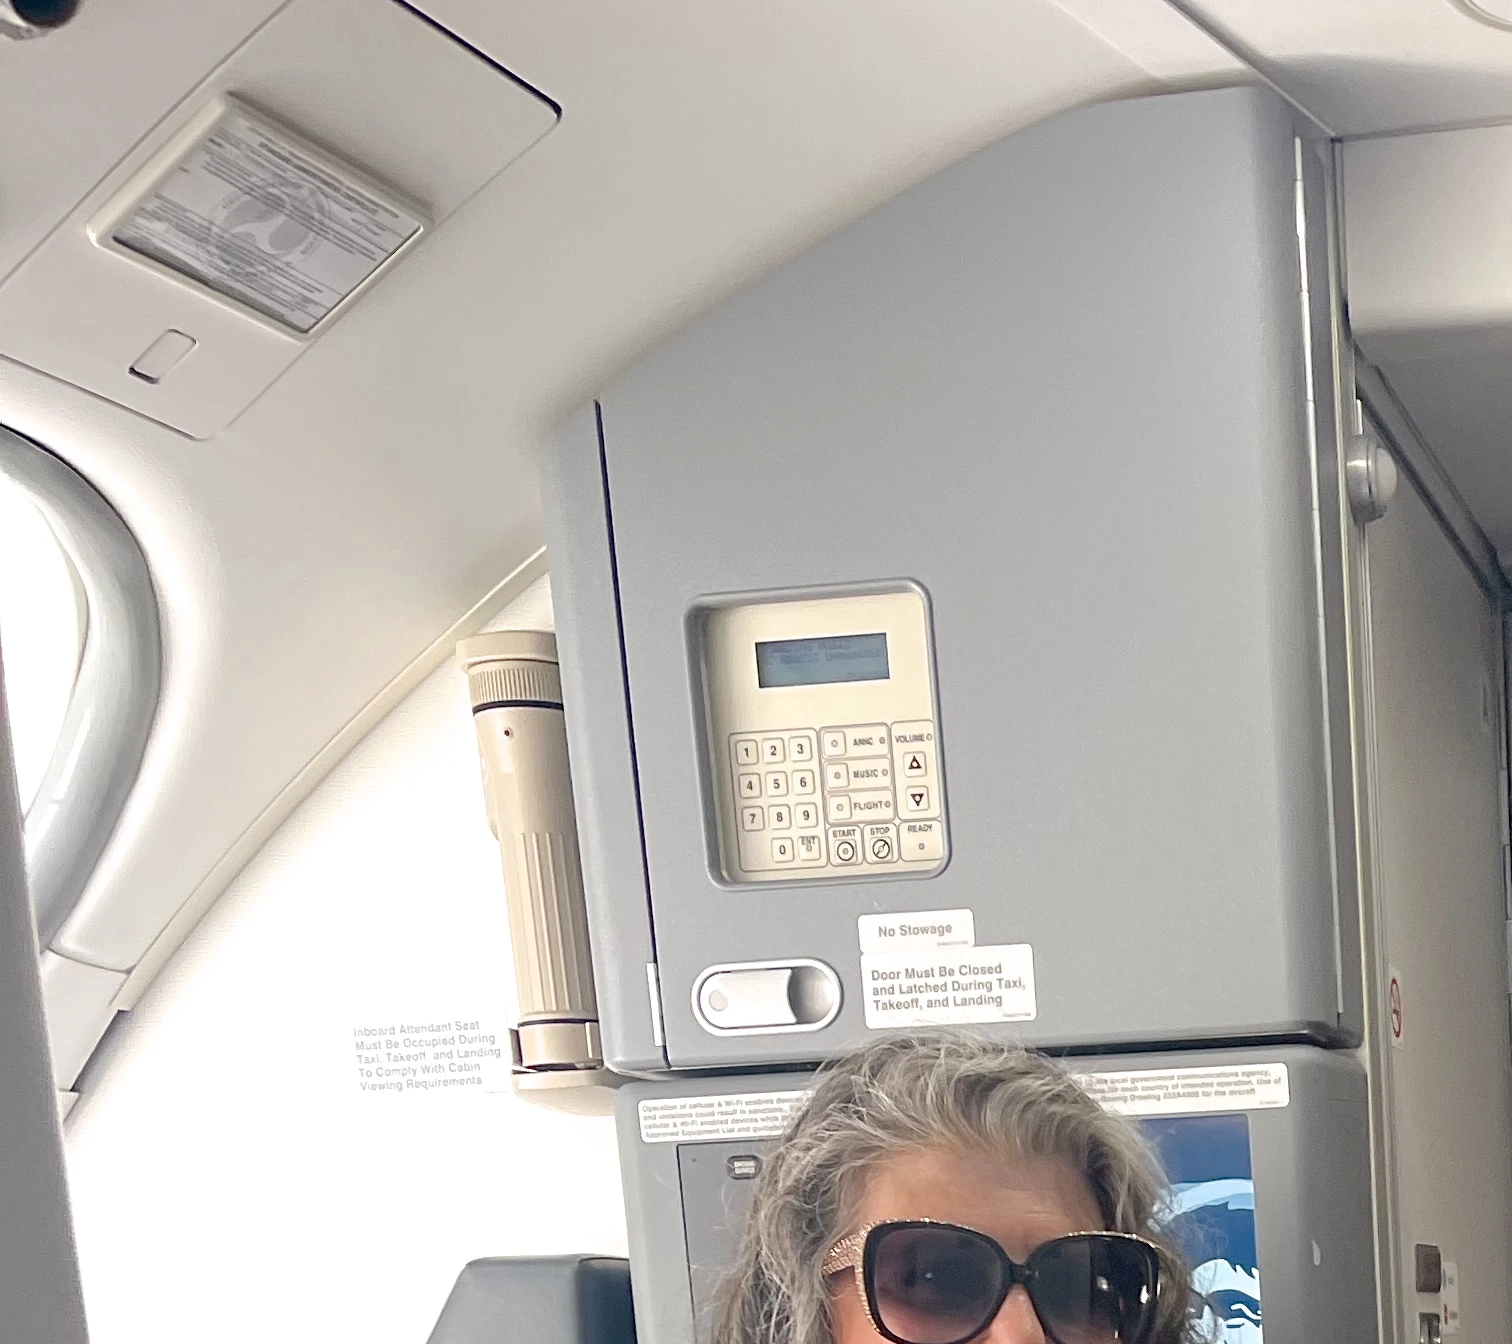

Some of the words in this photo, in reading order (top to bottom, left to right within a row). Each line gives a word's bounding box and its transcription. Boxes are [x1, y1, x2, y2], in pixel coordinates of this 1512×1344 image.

[853, 736, 874, 746] ANNC
[895, 733, 925, 744] VOLUME
[744, 746, 750, 758] 1
[769, 744, 777, 757] 2
[796, 743, 804, 755] 3
[853, 768, 879, 780] MUSIC
[746, 779, 754, 791] 4
[773, 778, 780, 790] 5
[799, 776, 807, 788] 6
[853, 800, 883, 811] FLIGHT
[749, 812, 757, 824] 7
[776, 811, 784, 823] 8
[802, 809, 810, 821] 9
[832, 828, 856, 838] START
[870, 826, 890, 836] STOP
[907, 823, 933, 834] READY
[779, 844, 787, 856] 0
[878, 926, 896, 937] No
[899, 923, 953, 937] Stowage
[871, 969, 901, 981] Door
[905, 966, 935, 979] Must
[939, 966, 955, 977] Be
[958, 963, 1003, 976] Closed
[872, 984, 895, 996] and
[899, 980, 948, 994] Latched
[951, 979, 993, 992] During
[996, 977, 1026, 990] Taxi,
[873, 997, 923, 1012] Takeoff,
[926, 996, 949, 1009] and
[953, 995, 1003, 1007] Landing
[353, 1026, 396, 1037] Inboard
[399, 1022, 452, 1034] Attendant
[454, 1020, 480, 1031] Seat
[355, 1040, 382, 1051] Must
[385, 1039, 400, 1049] Be
[403, 1036, 455, 1049] Occupied
[458, 1034, 496, 1045] During
[433, 1049, 454, 1060] and
[457, 1047, 501, 1058] Landing
[358, 1068, 373, 1078] To
[376, 1066, 417, 1078] Comply
[420, 1064, 445, 1074] With
[448, 1062, 481, 1073] Cabin
[360, 1080, 403, 1092] Viewing
[406, 1075, 483, 1091] Requirements
